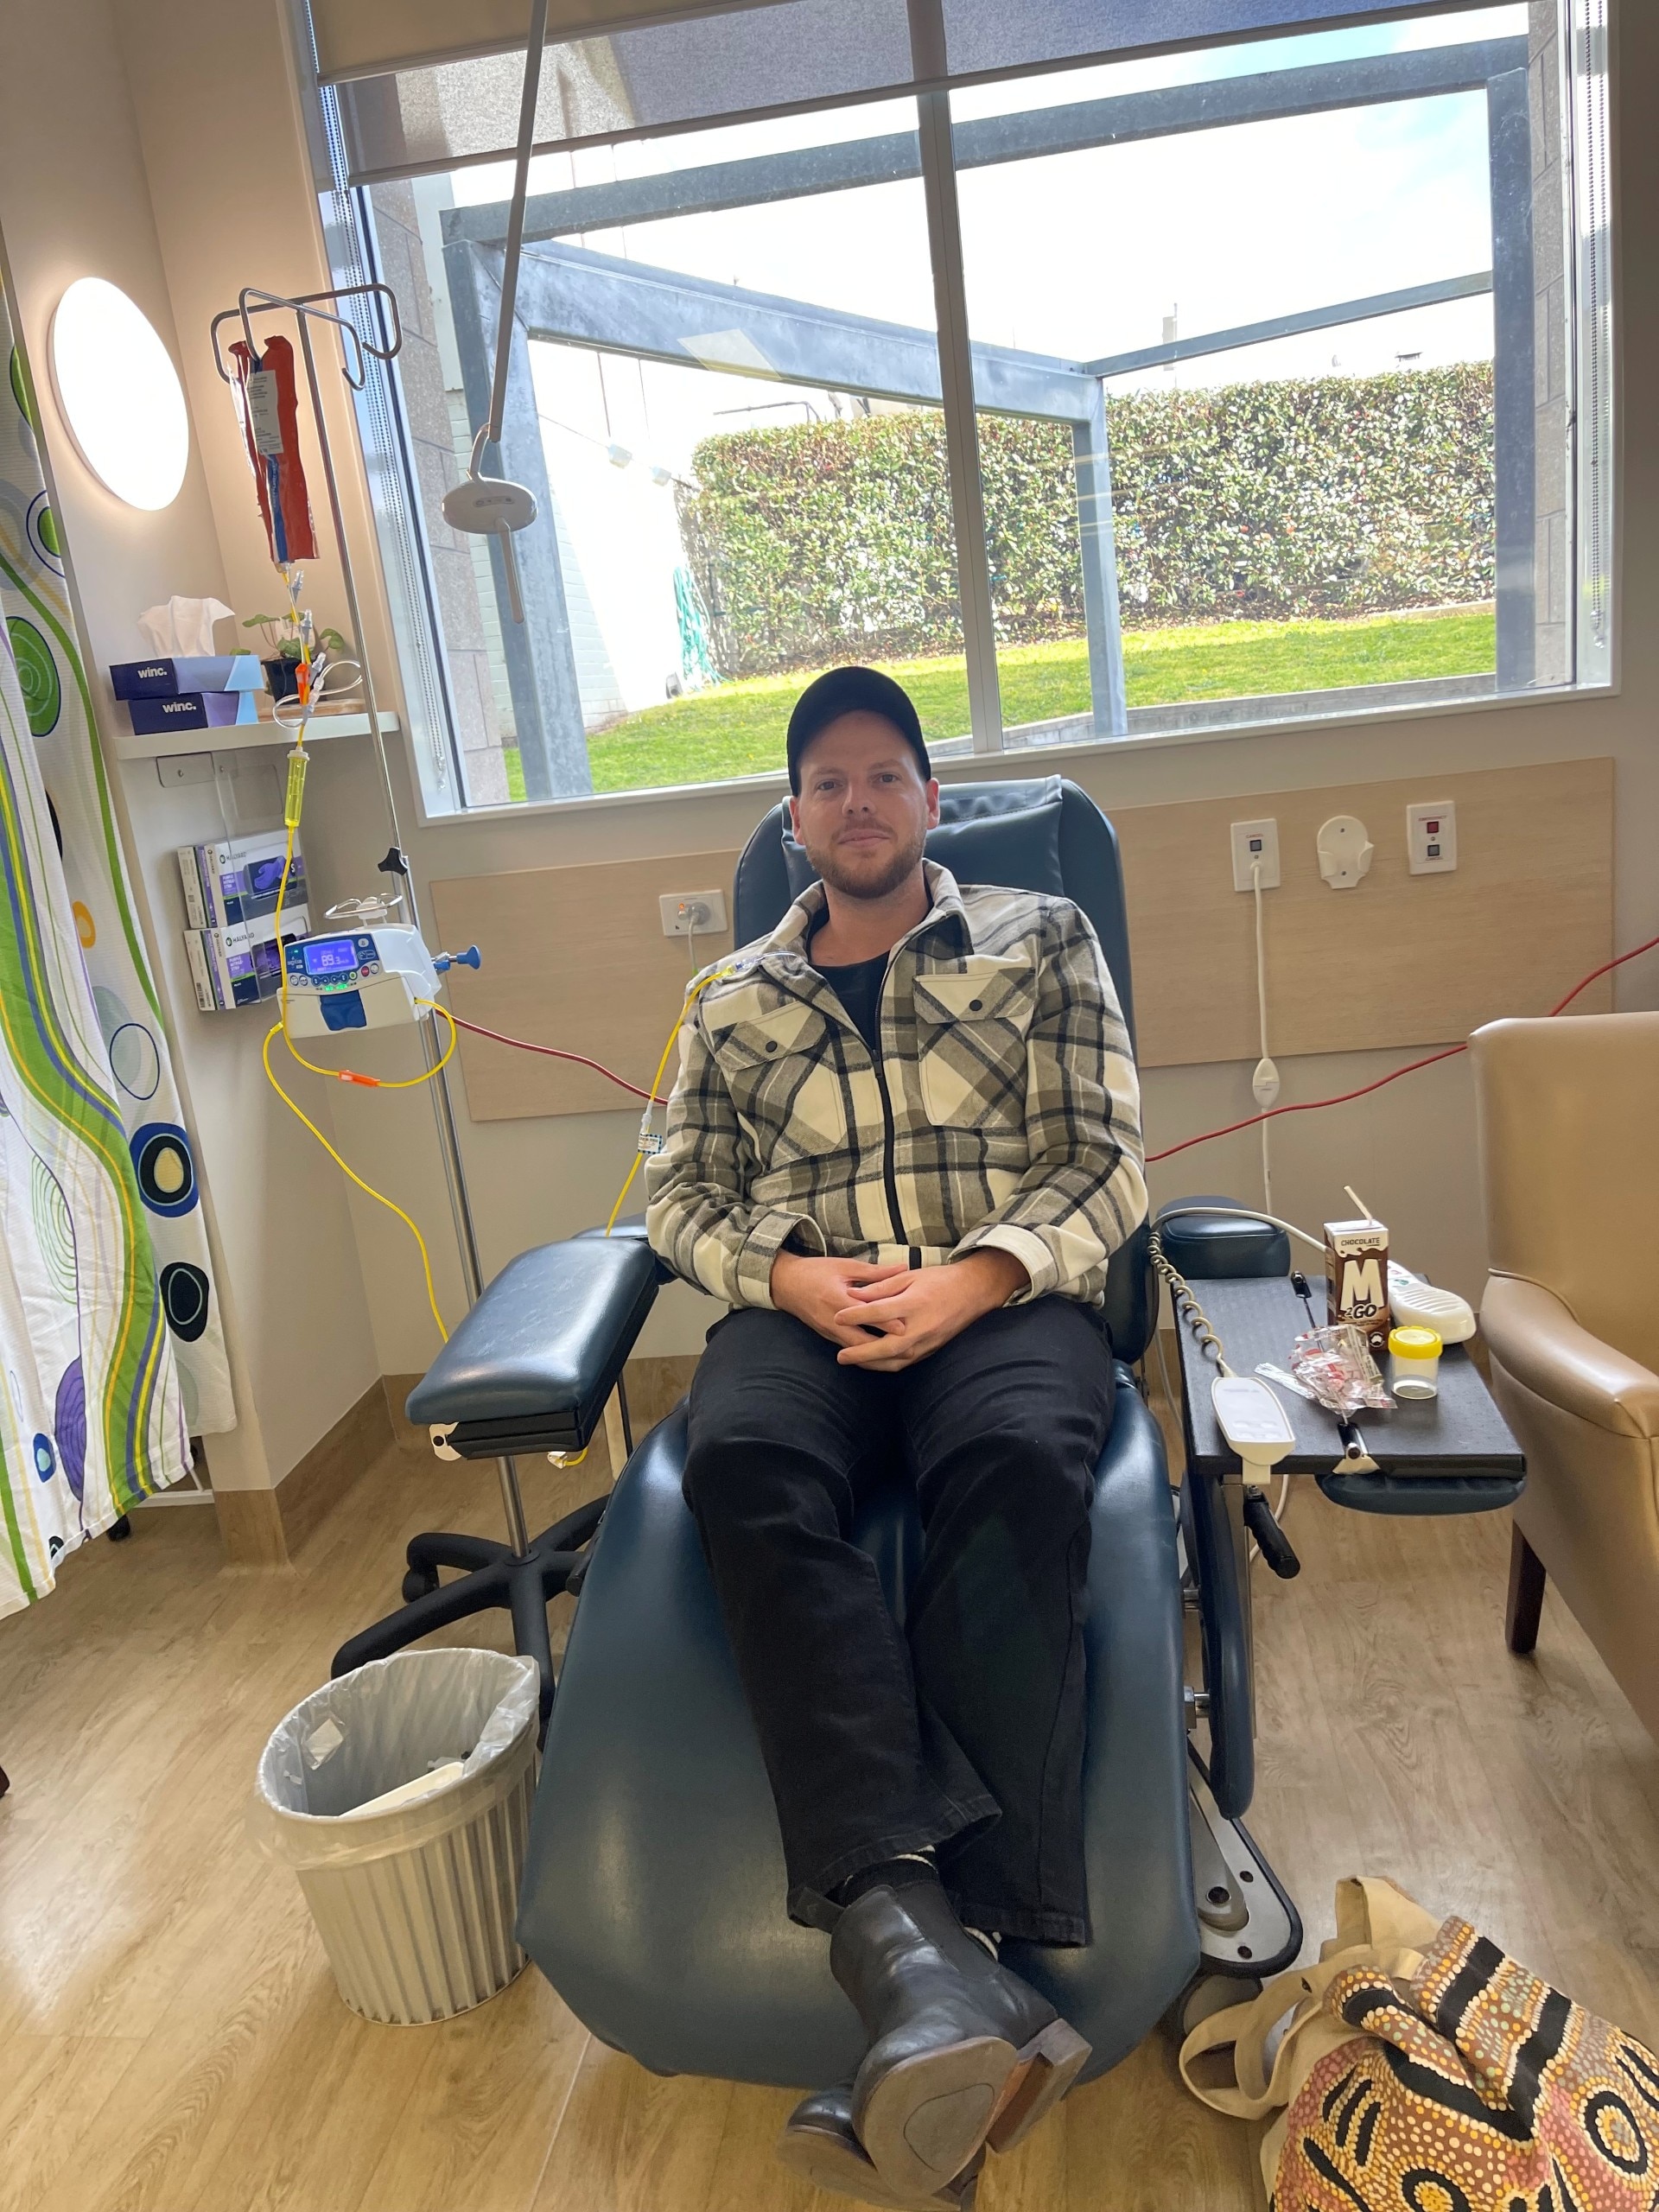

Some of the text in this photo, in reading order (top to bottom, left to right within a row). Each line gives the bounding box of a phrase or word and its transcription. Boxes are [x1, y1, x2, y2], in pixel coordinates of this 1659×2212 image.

[137, 667, 167, 678] winc.
[162, 702, 196, 713] winc.
[1340, 1237, 1380, 1246] CHOCOLATE
